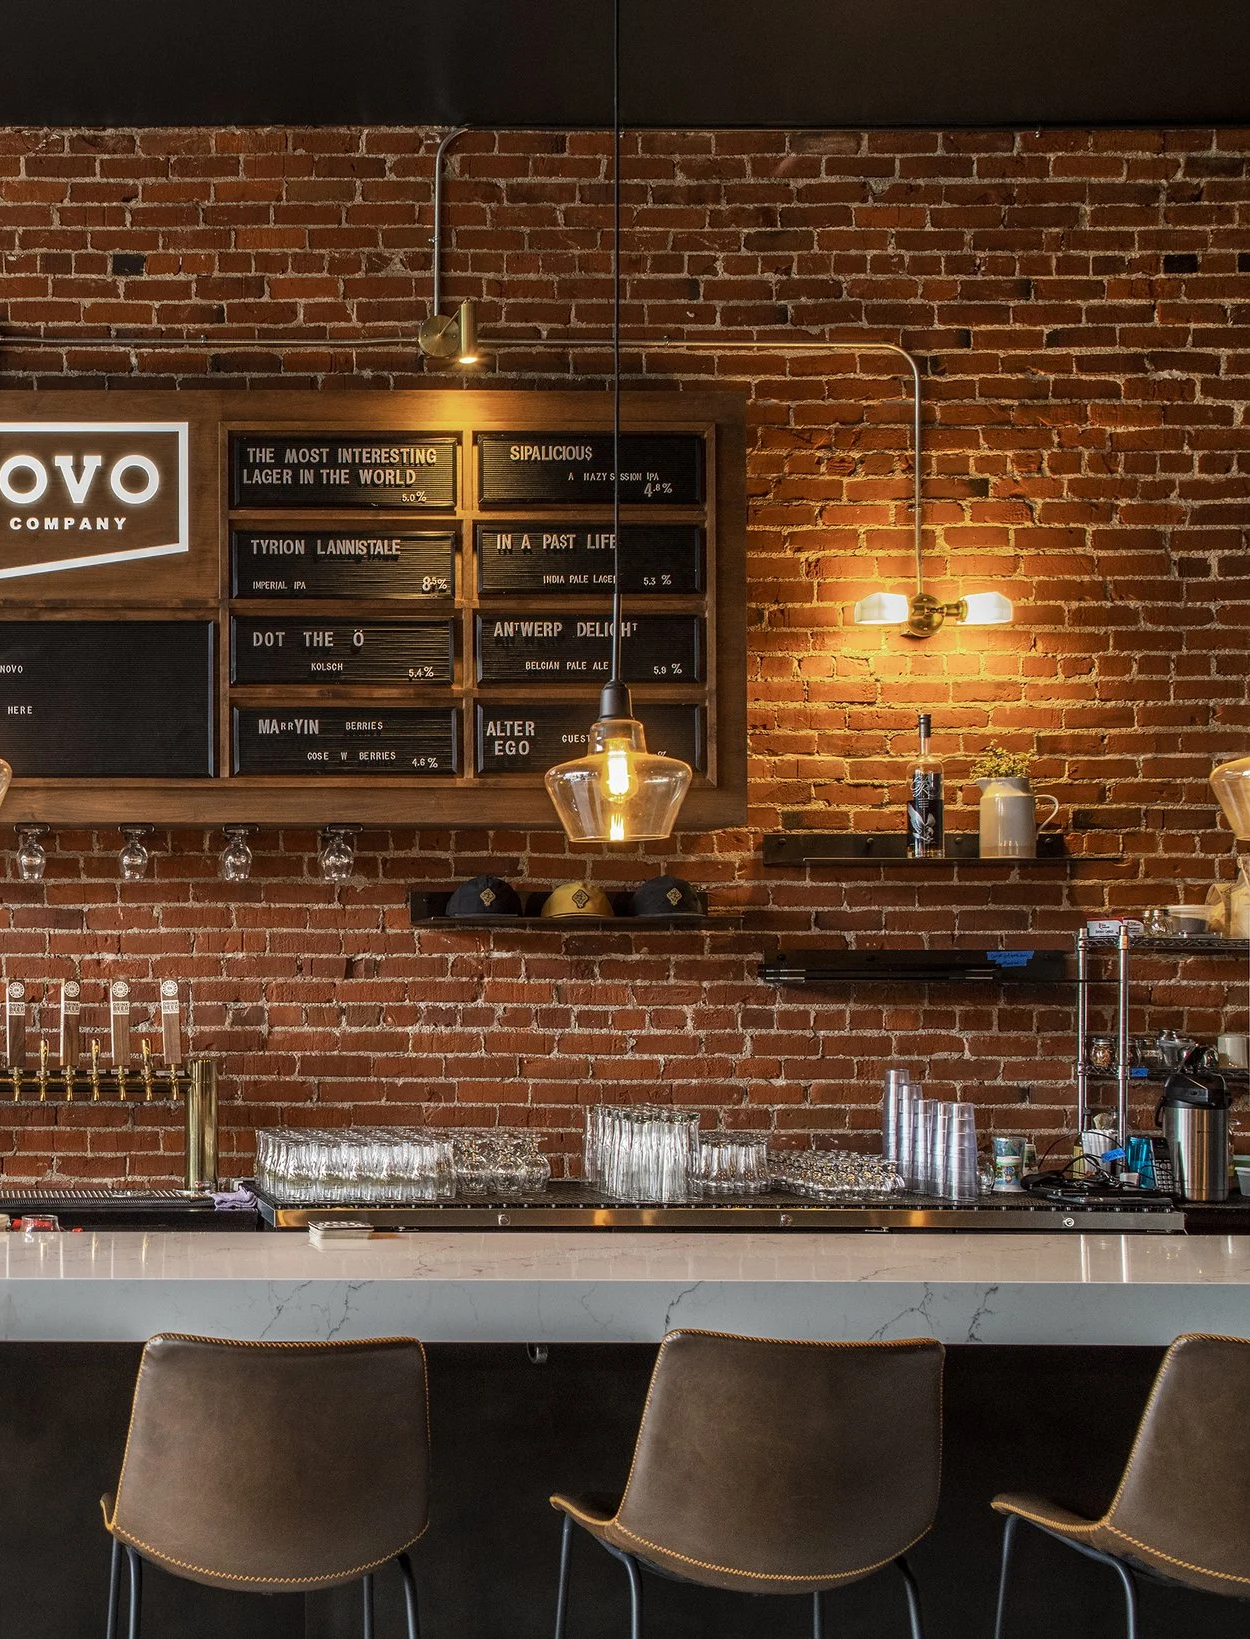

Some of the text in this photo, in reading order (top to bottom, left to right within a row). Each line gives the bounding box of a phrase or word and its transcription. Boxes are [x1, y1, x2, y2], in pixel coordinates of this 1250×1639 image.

[246, 448, 437, 464] THE MOST INTERESTING
[242, 468, 416, 484] LAGER IN THE WORLD
[568, 472, 659, 481] A HAZY SSSION IPA
[9, 517, 127, 530] COMPANY
[250, 539, 401, 555] TYRION LANNISTALE
[496, 534, 512, 550] IN
[521, 534, 532, 550] A
[586, 534, 617, 550] LIFE
[543, 575, 565, 584] INDIA
[569, 575, 589, 584] PALE
[252, 581, 306, 590] IMPERIAL IPA
[493, 621, 563, 637] ANTWERP
[253, 629, 364, 647] DOT THE Ö
[0, 664, 24, 674] NOVO
[311, 662, 343, 671] KOLSCH
[525, 661, 609, 670] BELGIAN PALE ALE
[7, 706, 33, 714] HERE
[345, 721, 383, 730] BERRIES
[486, 720, 535, 737] ALTER
[494, 740, 530, 756] EGO
[307, 751, 396, 761] GOSE W BERRIES
